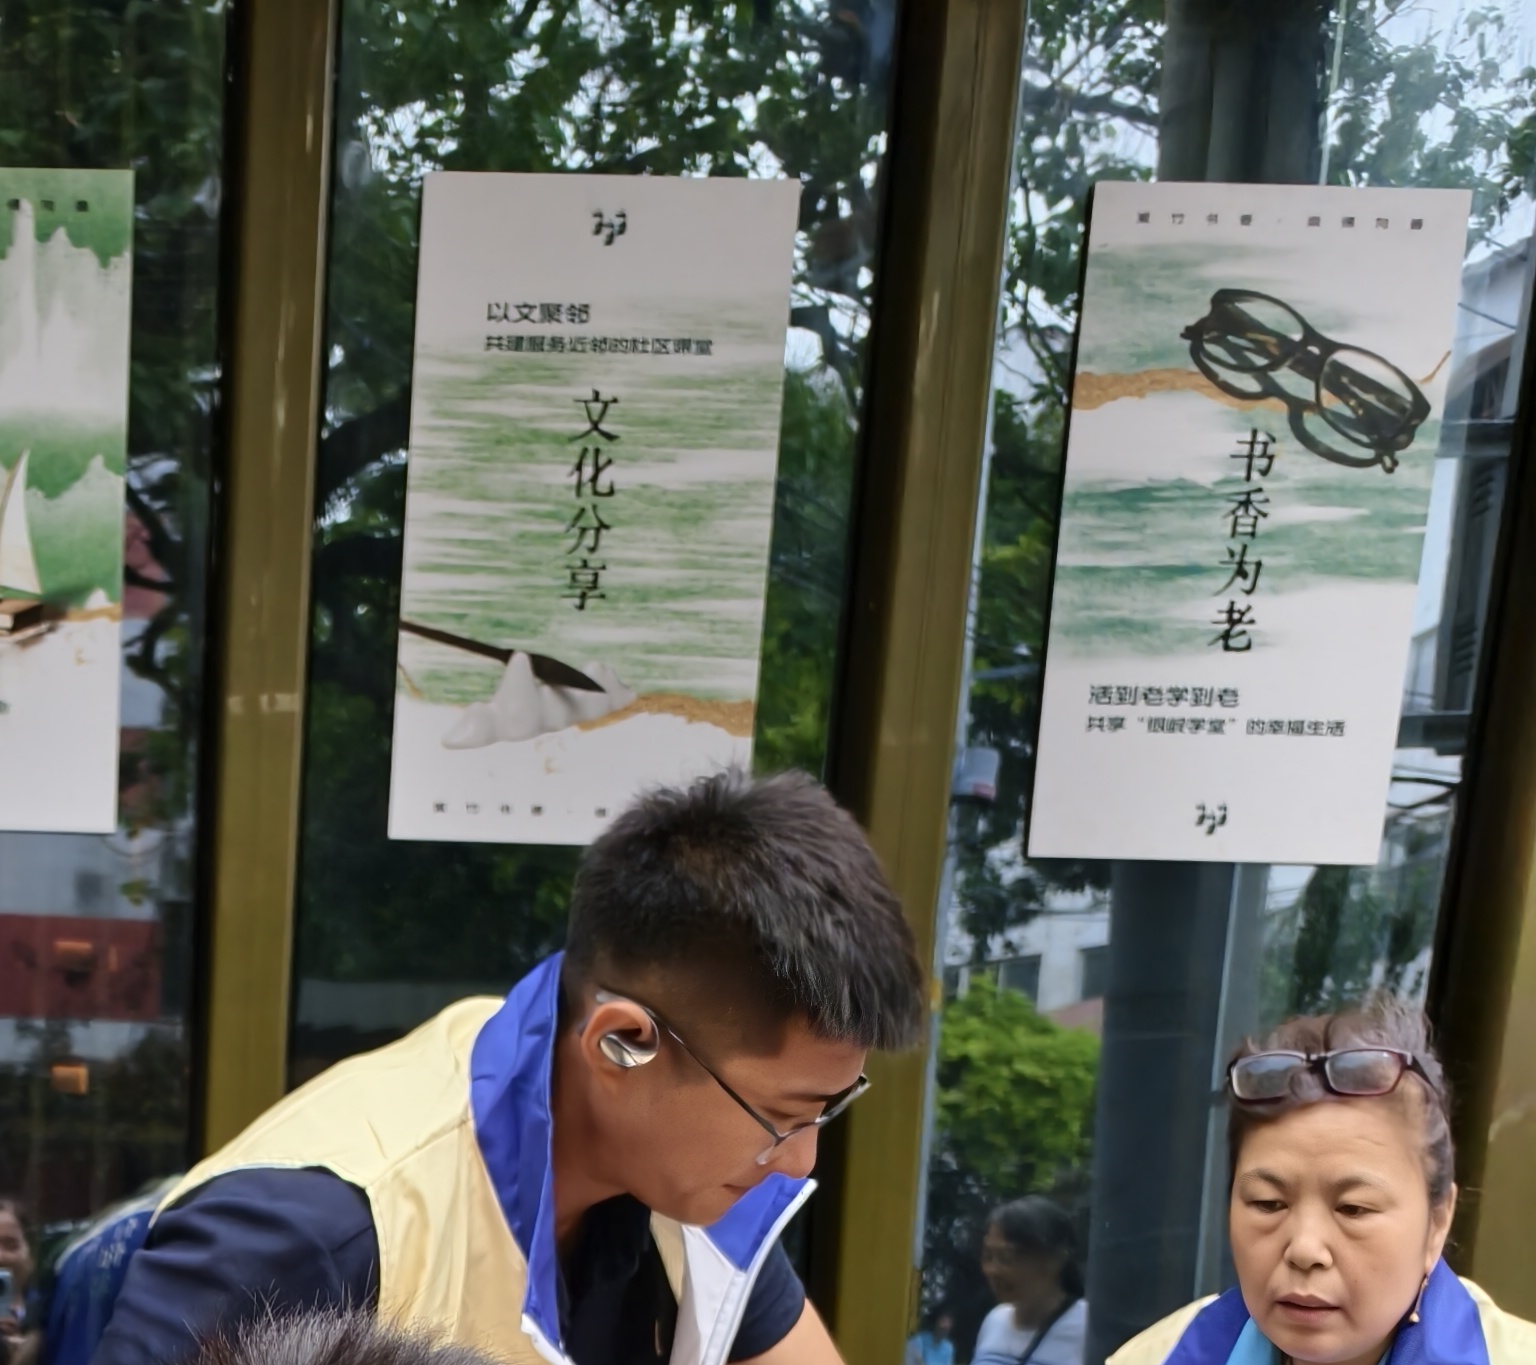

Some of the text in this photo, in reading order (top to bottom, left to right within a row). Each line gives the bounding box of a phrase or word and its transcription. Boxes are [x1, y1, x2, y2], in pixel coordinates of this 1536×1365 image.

[560, 388, 621, 611] 文化分享
[1206, 427, 1277, 653] 书香为老
[1087, 683, 1240, 708] 活到老学到老
